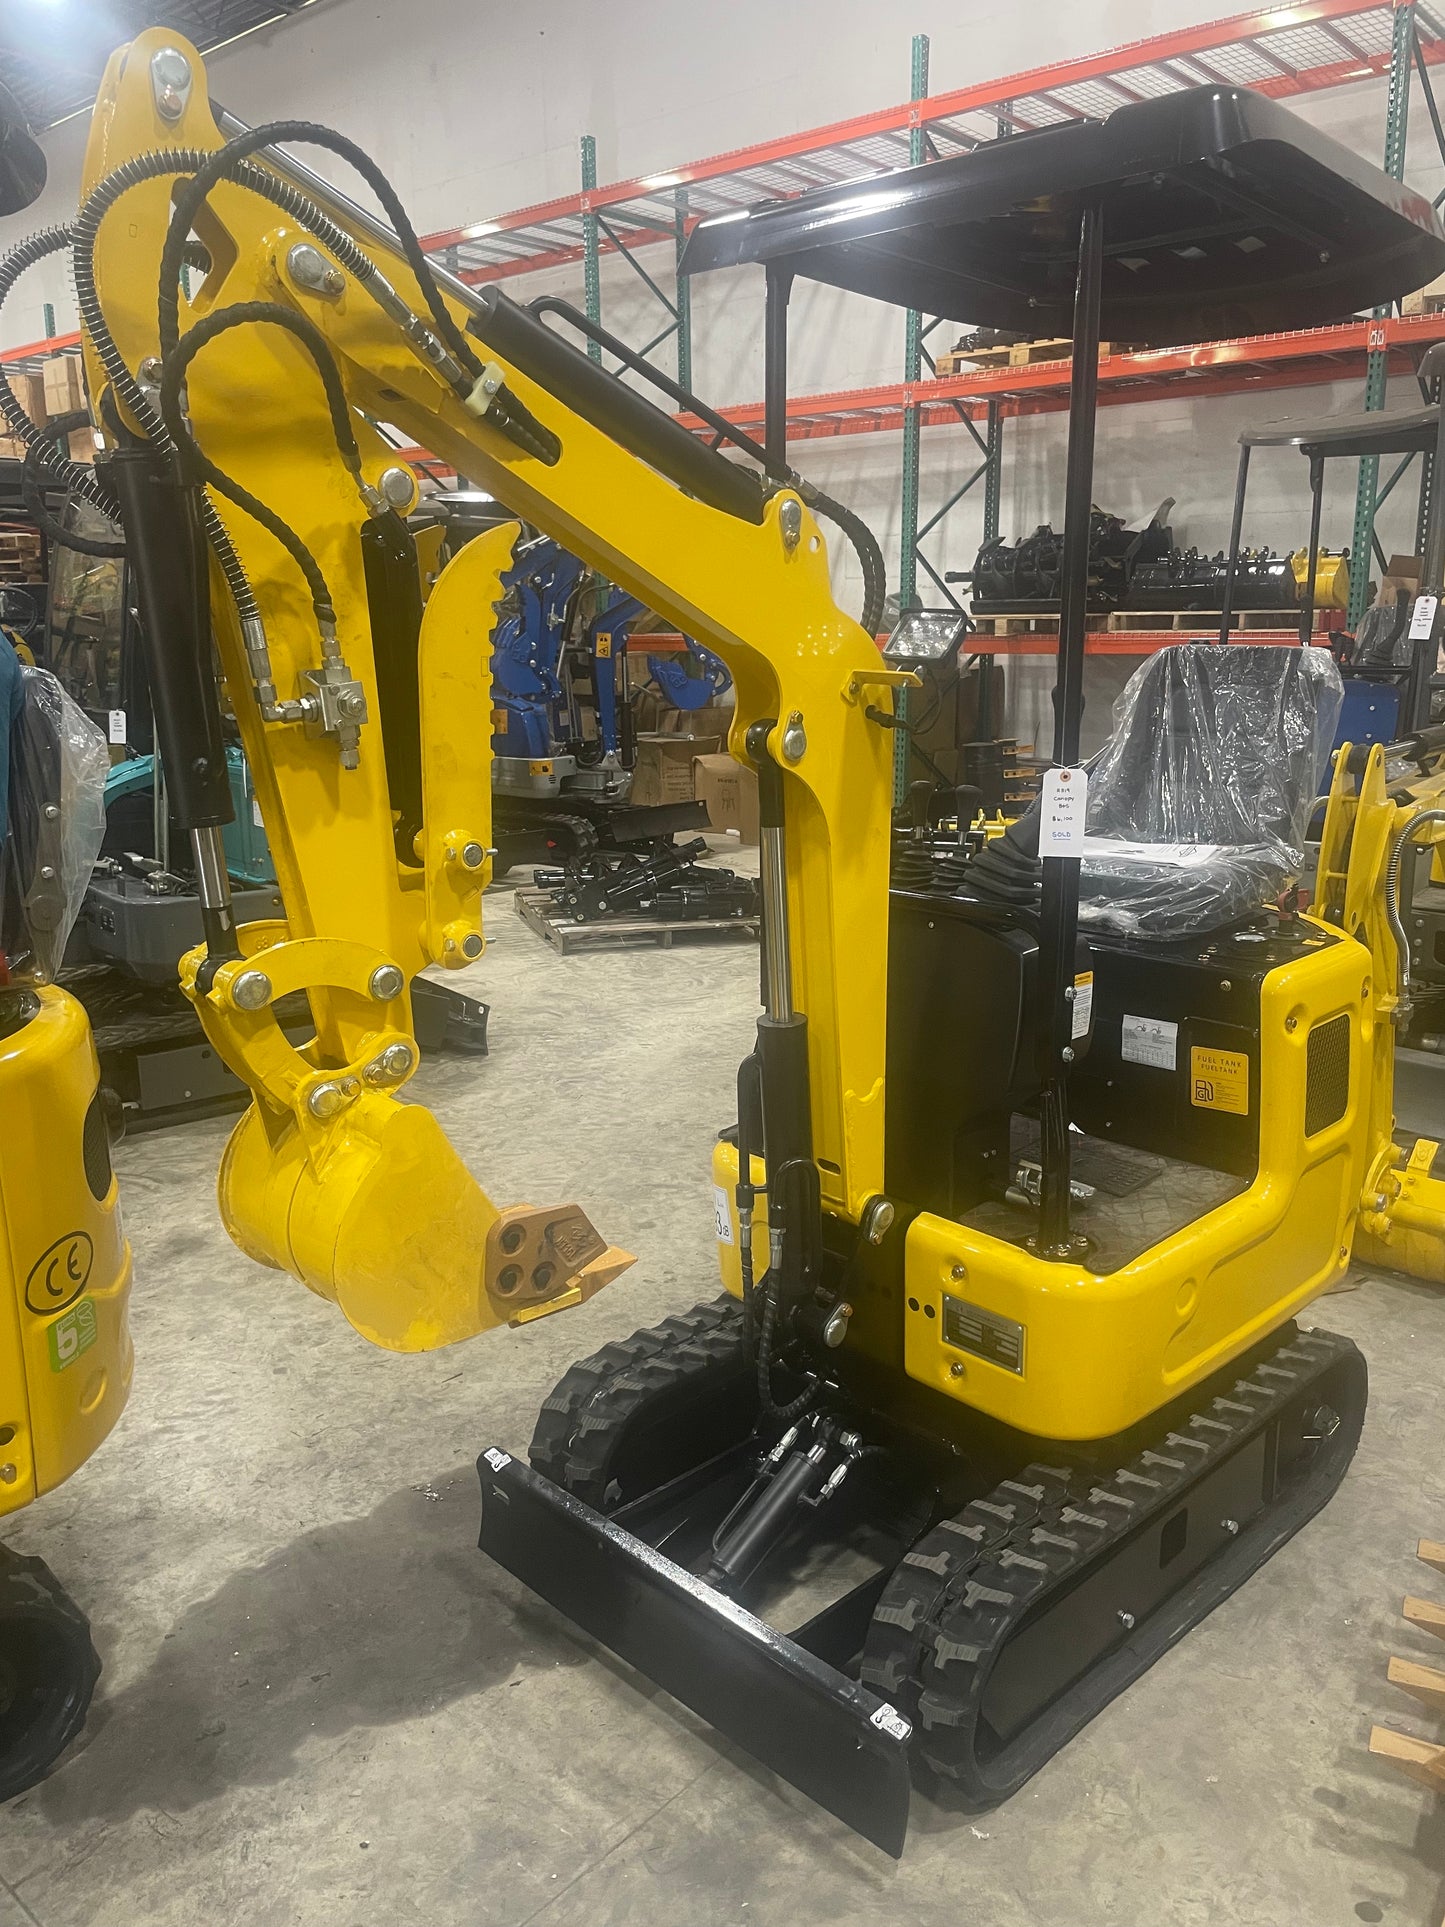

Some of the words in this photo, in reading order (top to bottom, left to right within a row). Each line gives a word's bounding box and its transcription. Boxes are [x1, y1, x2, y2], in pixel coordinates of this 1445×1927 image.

[1197, 1055, 1216, 1064] FUEL
[1220, 1059, 1241, 1067] TANK
[45, 1241, 82, 1296] CE
